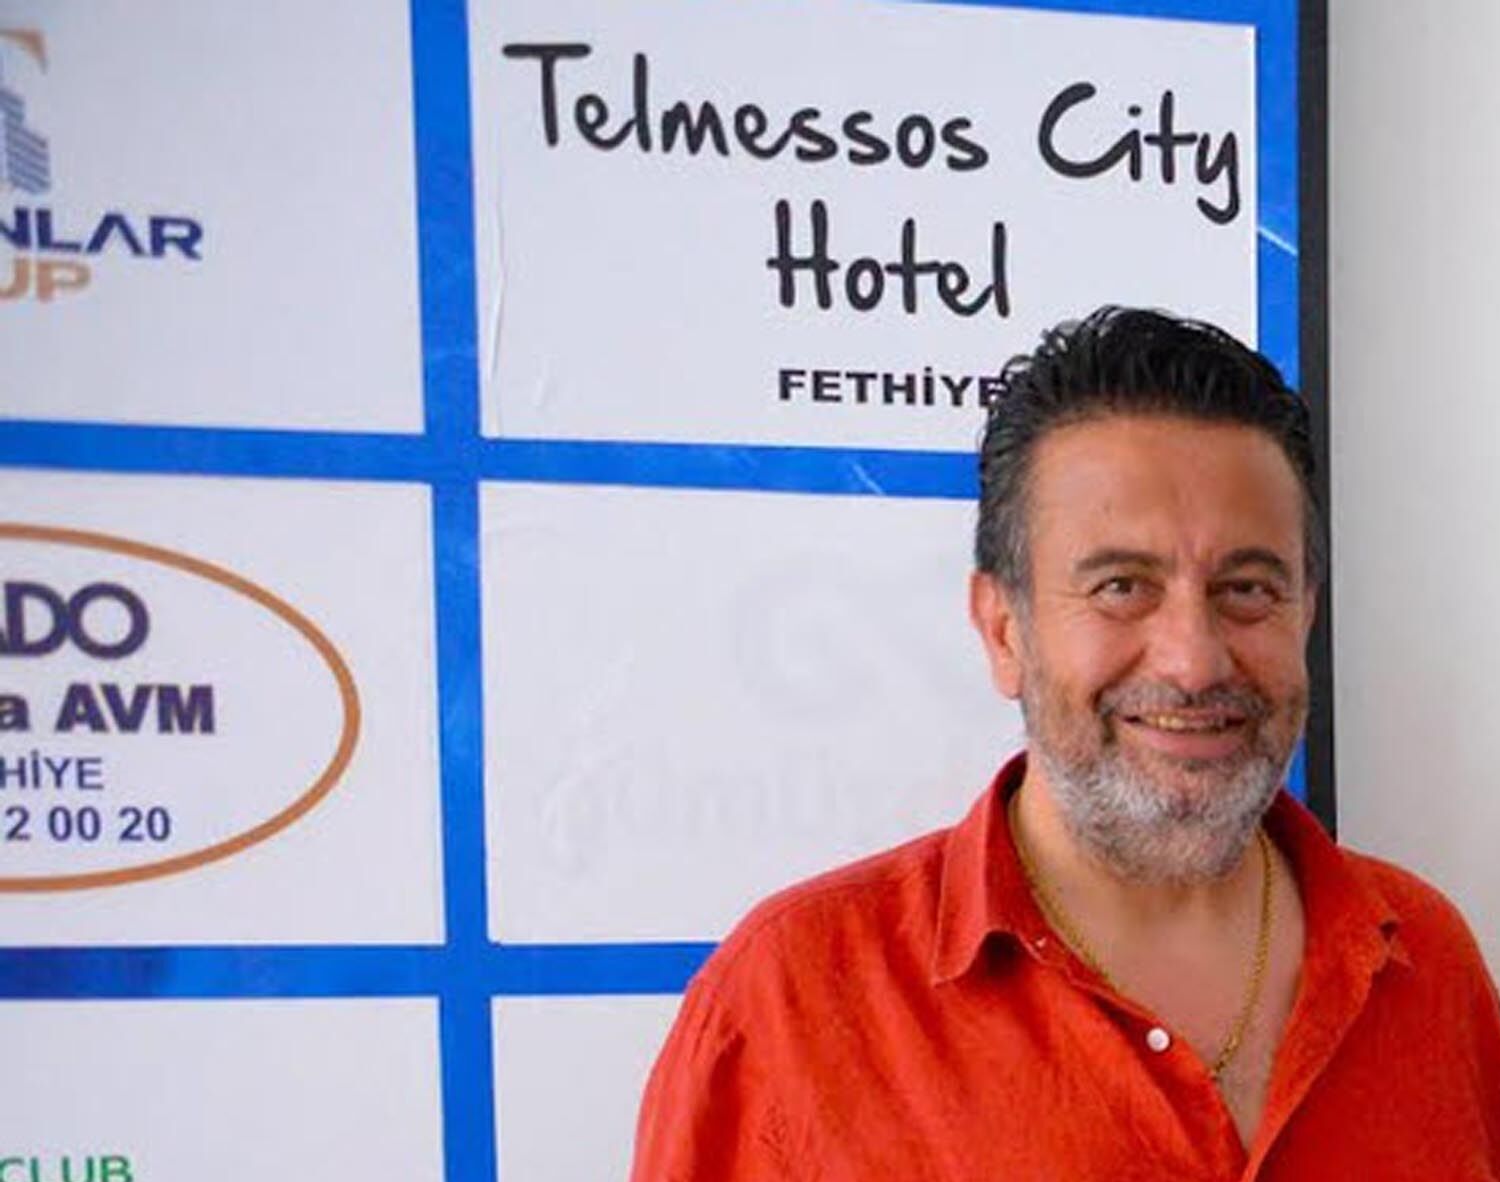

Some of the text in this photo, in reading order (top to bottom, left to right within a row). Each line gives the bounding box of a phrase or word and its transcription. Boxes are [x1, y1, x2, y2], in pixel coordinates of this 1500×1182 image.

[501, 42, 1241, 225] Telmessos City
[766, 199, 1010, 319] Hotel
[0, 582, 149, 660] DO
[54, 683, 215, 735] AVM
[5, 806, 171, 842] 2 00 20
